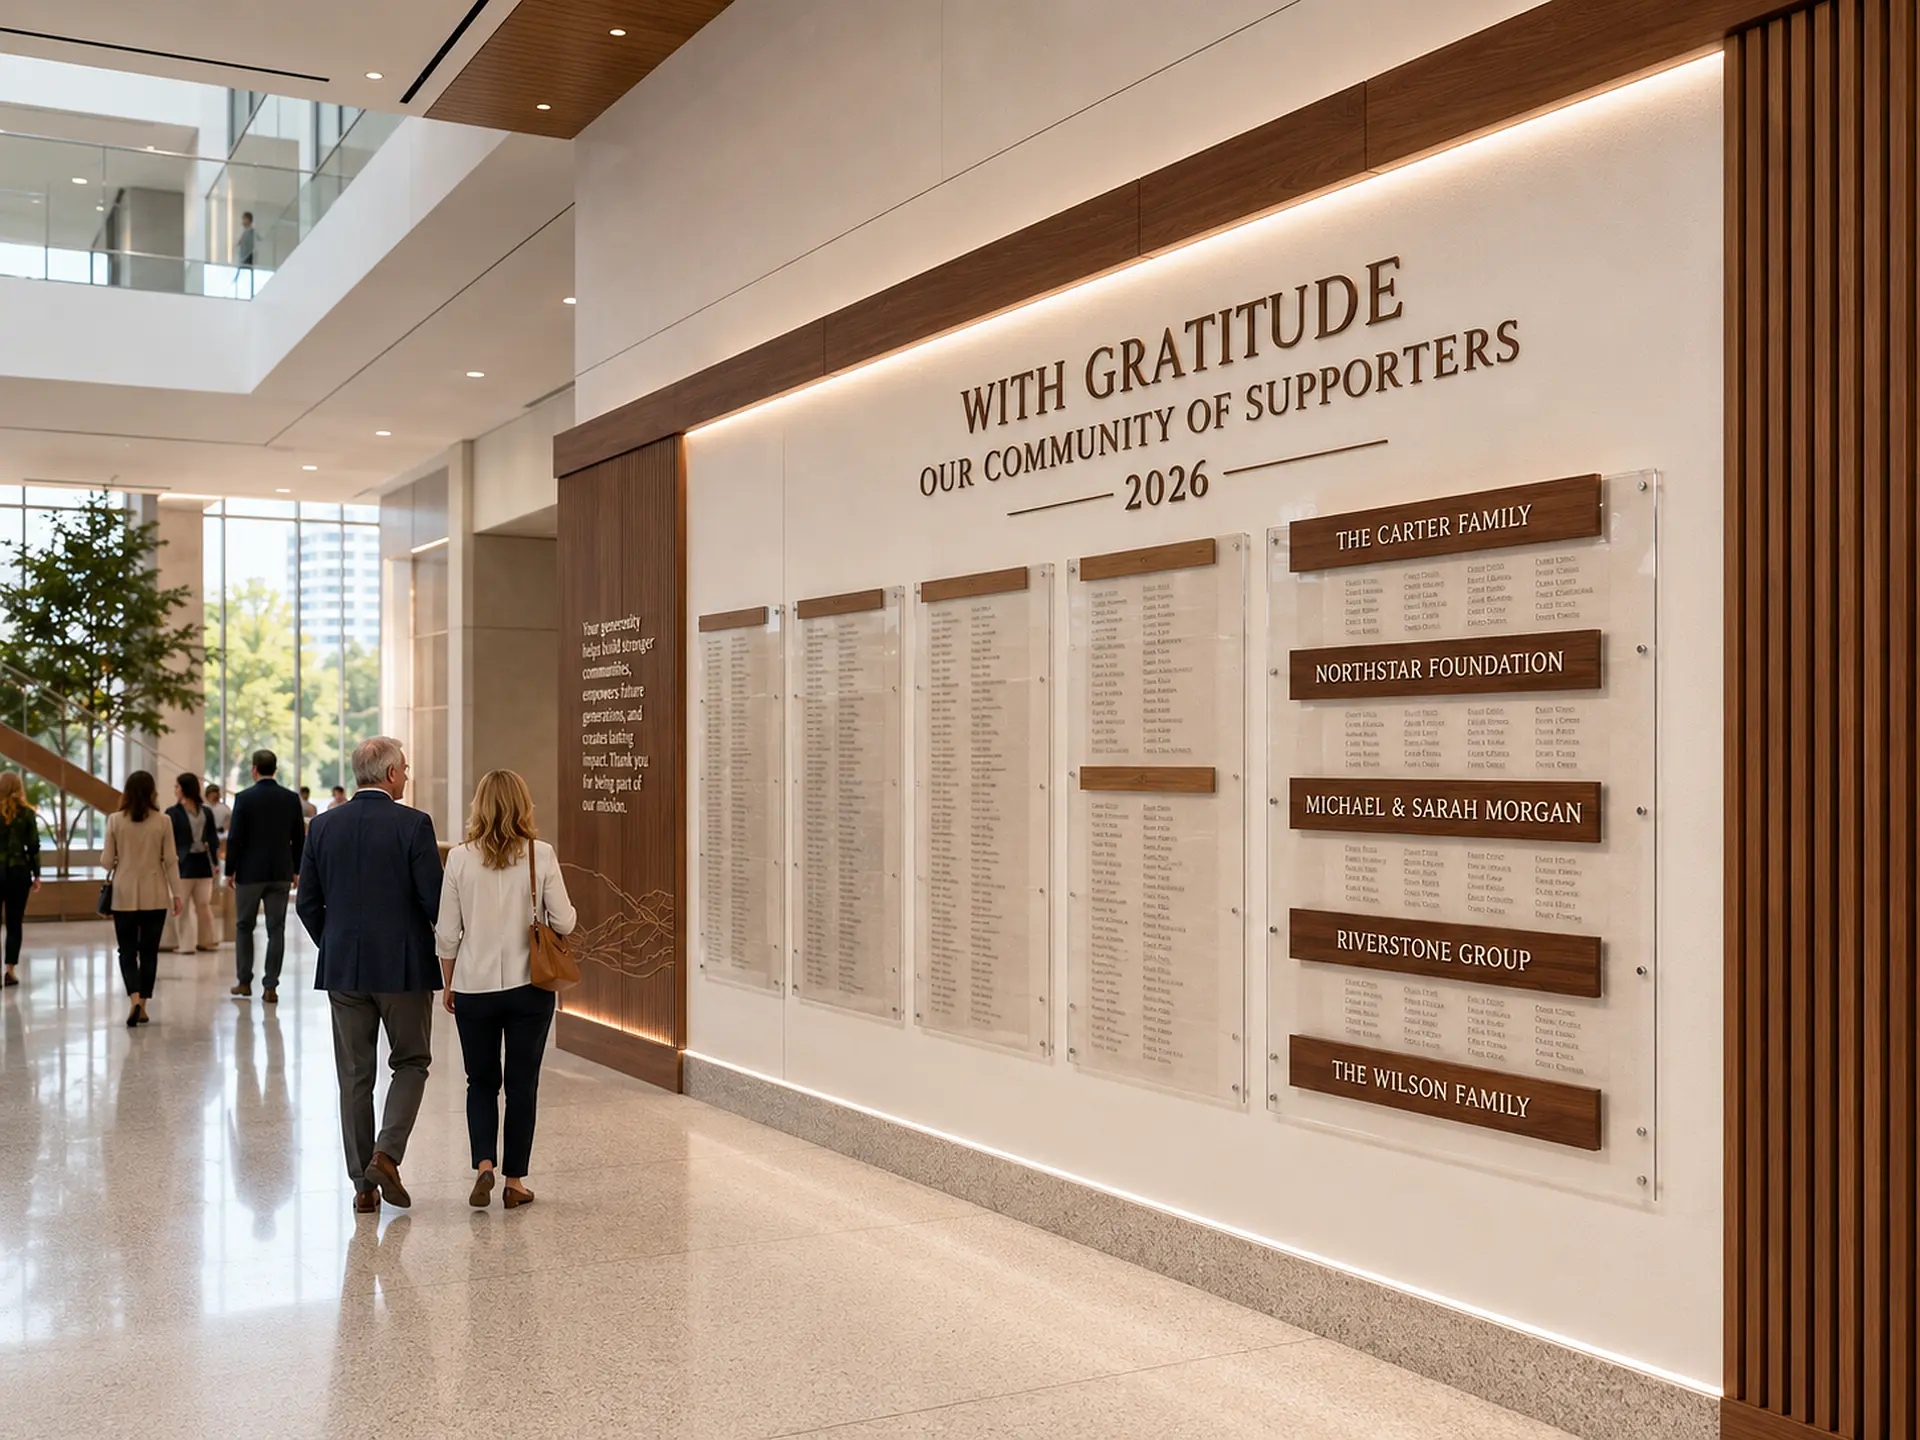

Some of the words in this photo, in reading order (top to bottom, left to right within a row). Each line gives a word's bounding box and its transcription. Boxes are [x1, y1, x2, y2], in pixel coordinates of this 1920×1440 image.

[961, 360, 1065, 434] WITH
[1085, 256, 1403, 400] GRATITUDE
[920, 458, 974, 496] OUR
[984, 406, 1176, 482] COMMUNITY
[1187, 392, 1231, 433] OF
[1245, 319, 1520, 421] SUPPORTERS
[1125, 460, 1208, 510] 2026
[1336, 528, 1371, 550] THE
[1378, 517, 1450, 544] CARTER
[1459, 504, 1531, 533] FAMILY
[582, 621, 599, 636] Your
[601, 614, 641, 637] generosity
[582, 642, 601, 661] helps
[602, 638, 621, 656] build
[622, 637, 655, 655] stronger
[582, 661, 632, 680] communities,
[1316, 660, 1422, 683] NORTHSTAR
[1429, 651, 1563, 677] FOUNDATION
[582, 687, 620, 705] empowers
[621, 682, 644, 699] future
[582, 708, 626, 727] generations,
[627, 705, 643, 721] and
[609, 729, 634, 748] lasting
[609, 752, 633, 767] Thank
[634, 755, 649, 770] you
[582, 774, 593, 789] for
[595, 775, 615, 793] being
[616, 777, 632, 794] part
[633, 774, 643, 791] of
[582, 799, 595, 811] our
[1307, 795, 1385, 815] MICHAEL
[1392, 798, 1405, 816] &
[1413, 798, 1477, 819] SARAH
[1486, 800, 1581, 823] MORGAN
[1338, 930, 1451, 961] RIVERSTONE
[1460, 944, 1530, 970] GROUP
[1332, 1060, 1366, 1084] THE
[1374, 1068, 1446, 1100] WILSON
[1456, 1085, 1530, 1117] FAMILY
